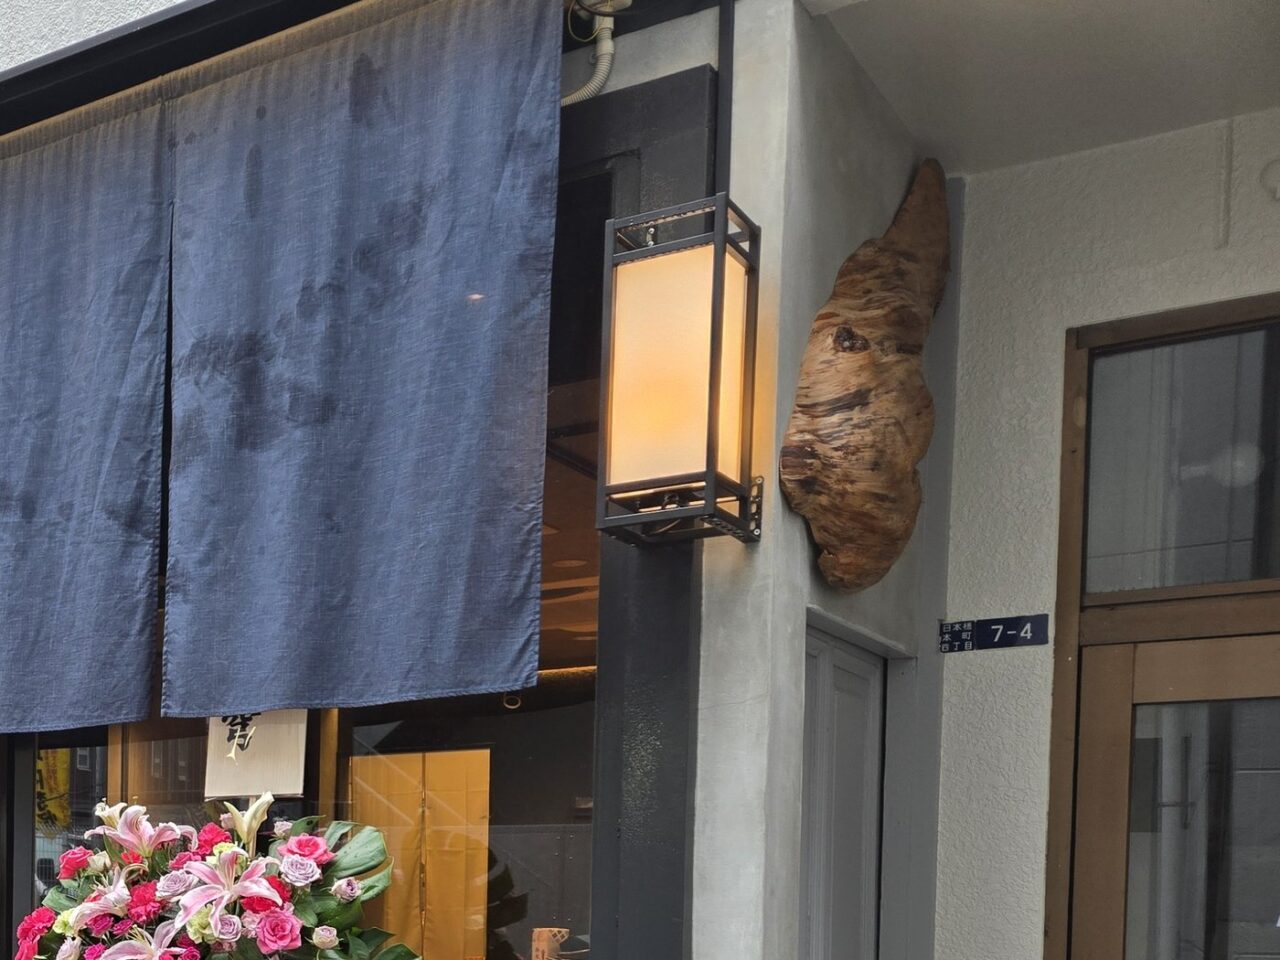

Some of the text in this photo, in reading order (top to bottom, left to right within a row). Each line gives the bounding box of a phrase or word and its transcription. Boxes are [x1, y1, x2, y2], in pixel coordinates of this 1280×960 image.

[991, 622, 1032, 642] 7-4
[941, 641, 973, 652] 四丁目
